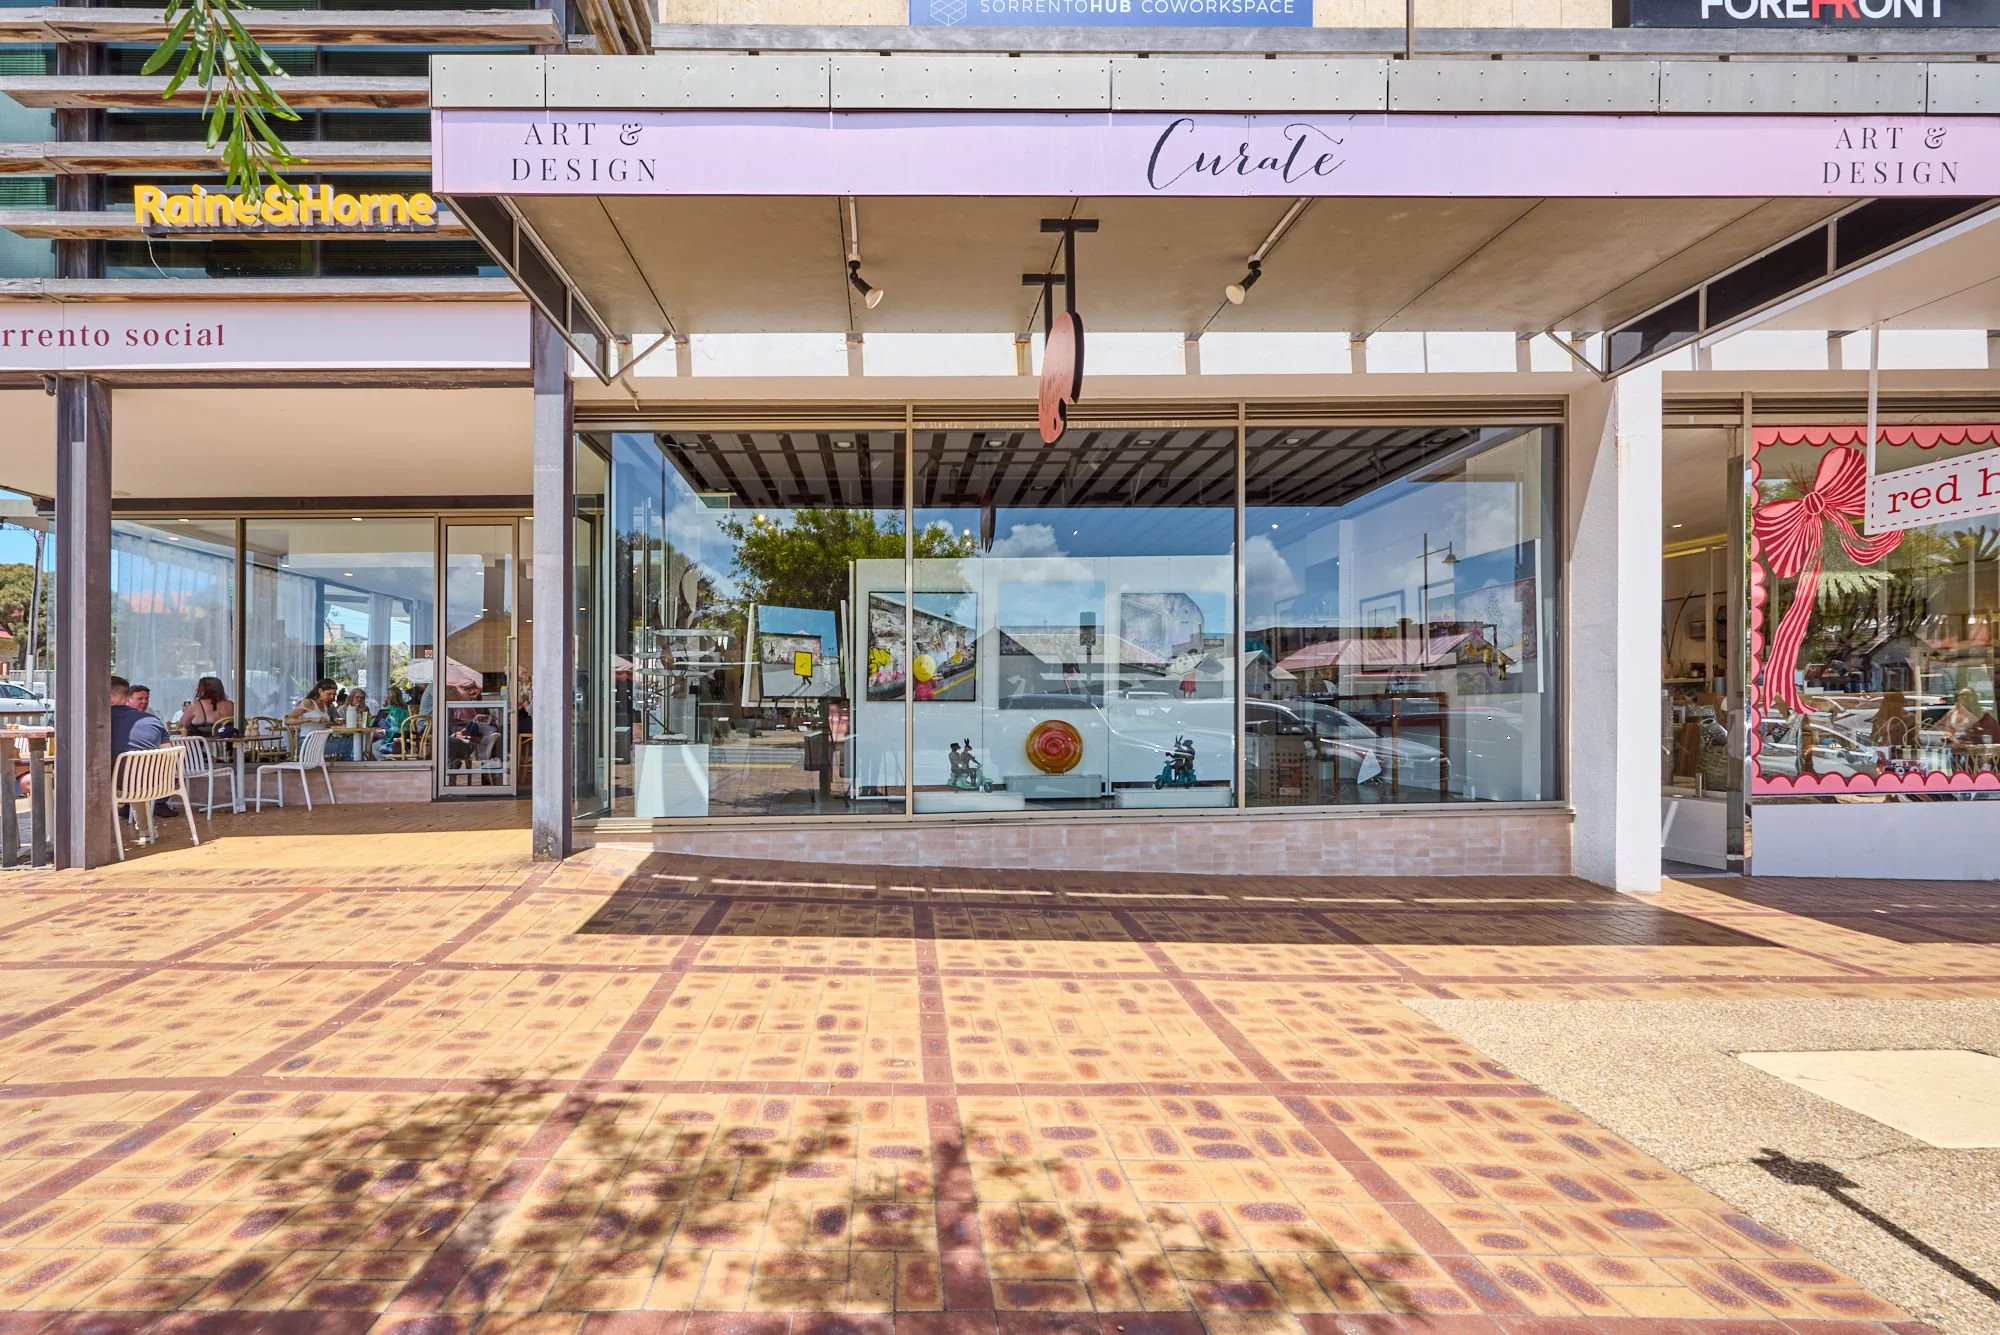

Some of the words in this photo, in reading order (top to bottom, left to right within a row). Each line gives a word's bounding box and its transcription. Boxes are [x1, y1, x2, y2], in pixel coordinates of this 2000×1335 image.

[981, 0, 1131, 13] SORRENTOHUB
[1142, 0, 1294, 14] COWORKSPACE
[1701, 0, 1940, 19] FOREFRONT
[525, 122, 596, 145] ART
[620, 123, 643, 145] &
[1835, 127, 1903, 149] ART
[1924, 127, 1947, 149] &
[1147, 118, 1345, 190] Curate
[511, 158, 657, 182] DESIGN
[1822, 161, 1959, 184] DESIGN
[134, 184, 435, 225] Raine&Horne
[1, 324, 110, 347] rrento
[125, 323, 225, 347] social
[1888, 474, 1962, 514] red
